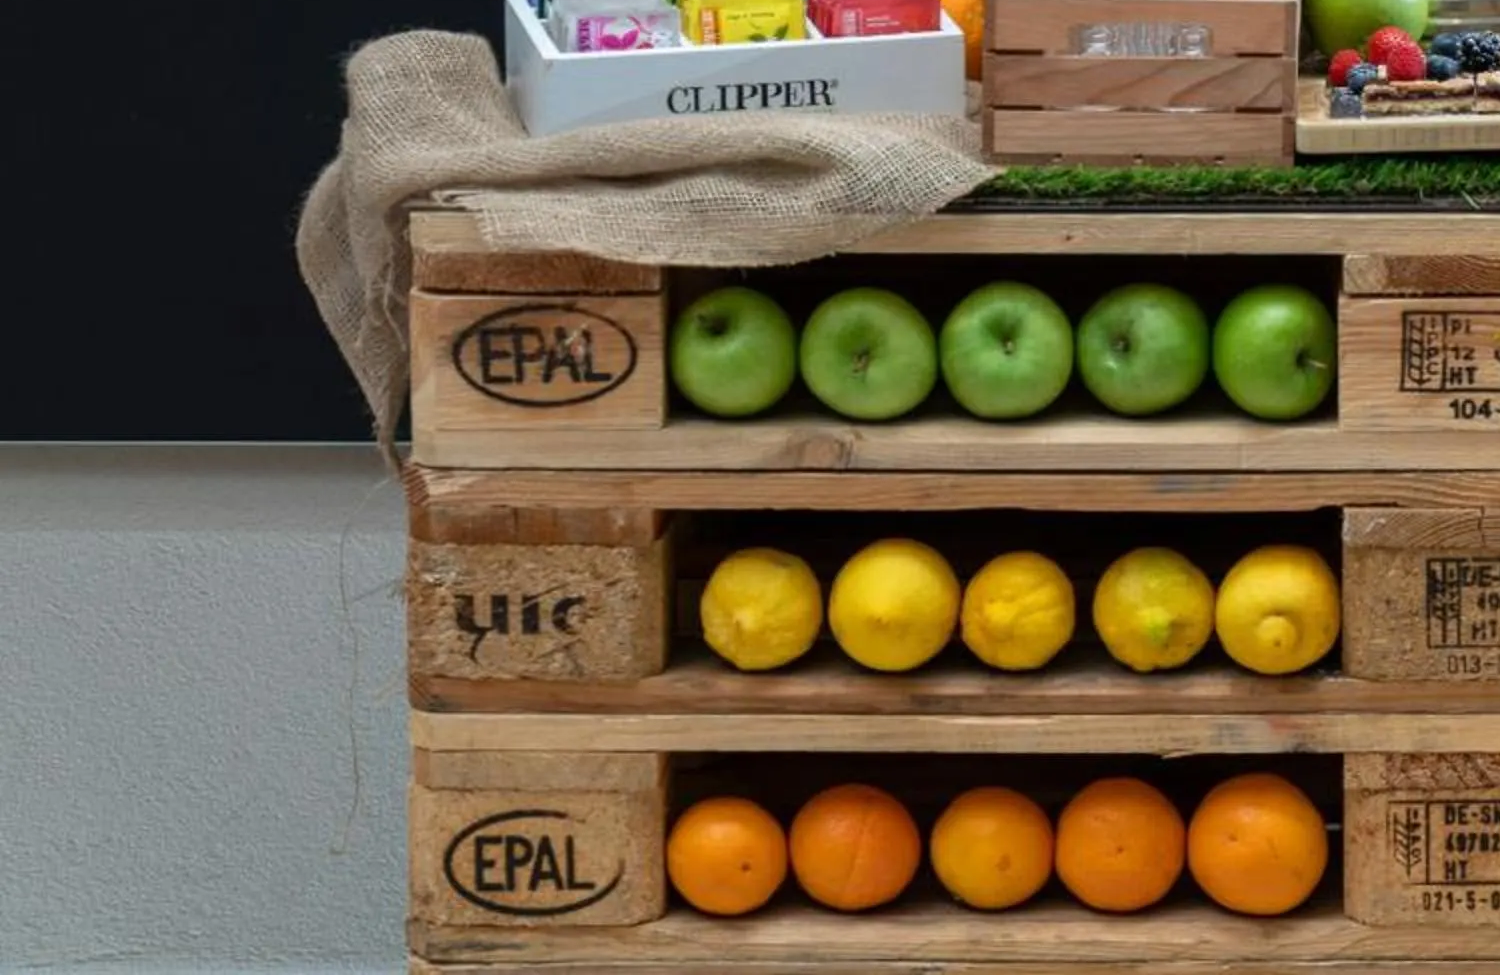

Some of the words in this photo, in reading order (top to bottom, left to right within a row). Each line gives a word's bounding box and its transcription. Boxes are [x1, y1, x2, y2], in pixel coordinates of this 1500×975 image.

[479, 325, 612, 383] EPAL
[1449, 366, 1478, 385] HT
[474, 835, 595, 891] EPAL
[1444, 860, 1469, 880] HT
